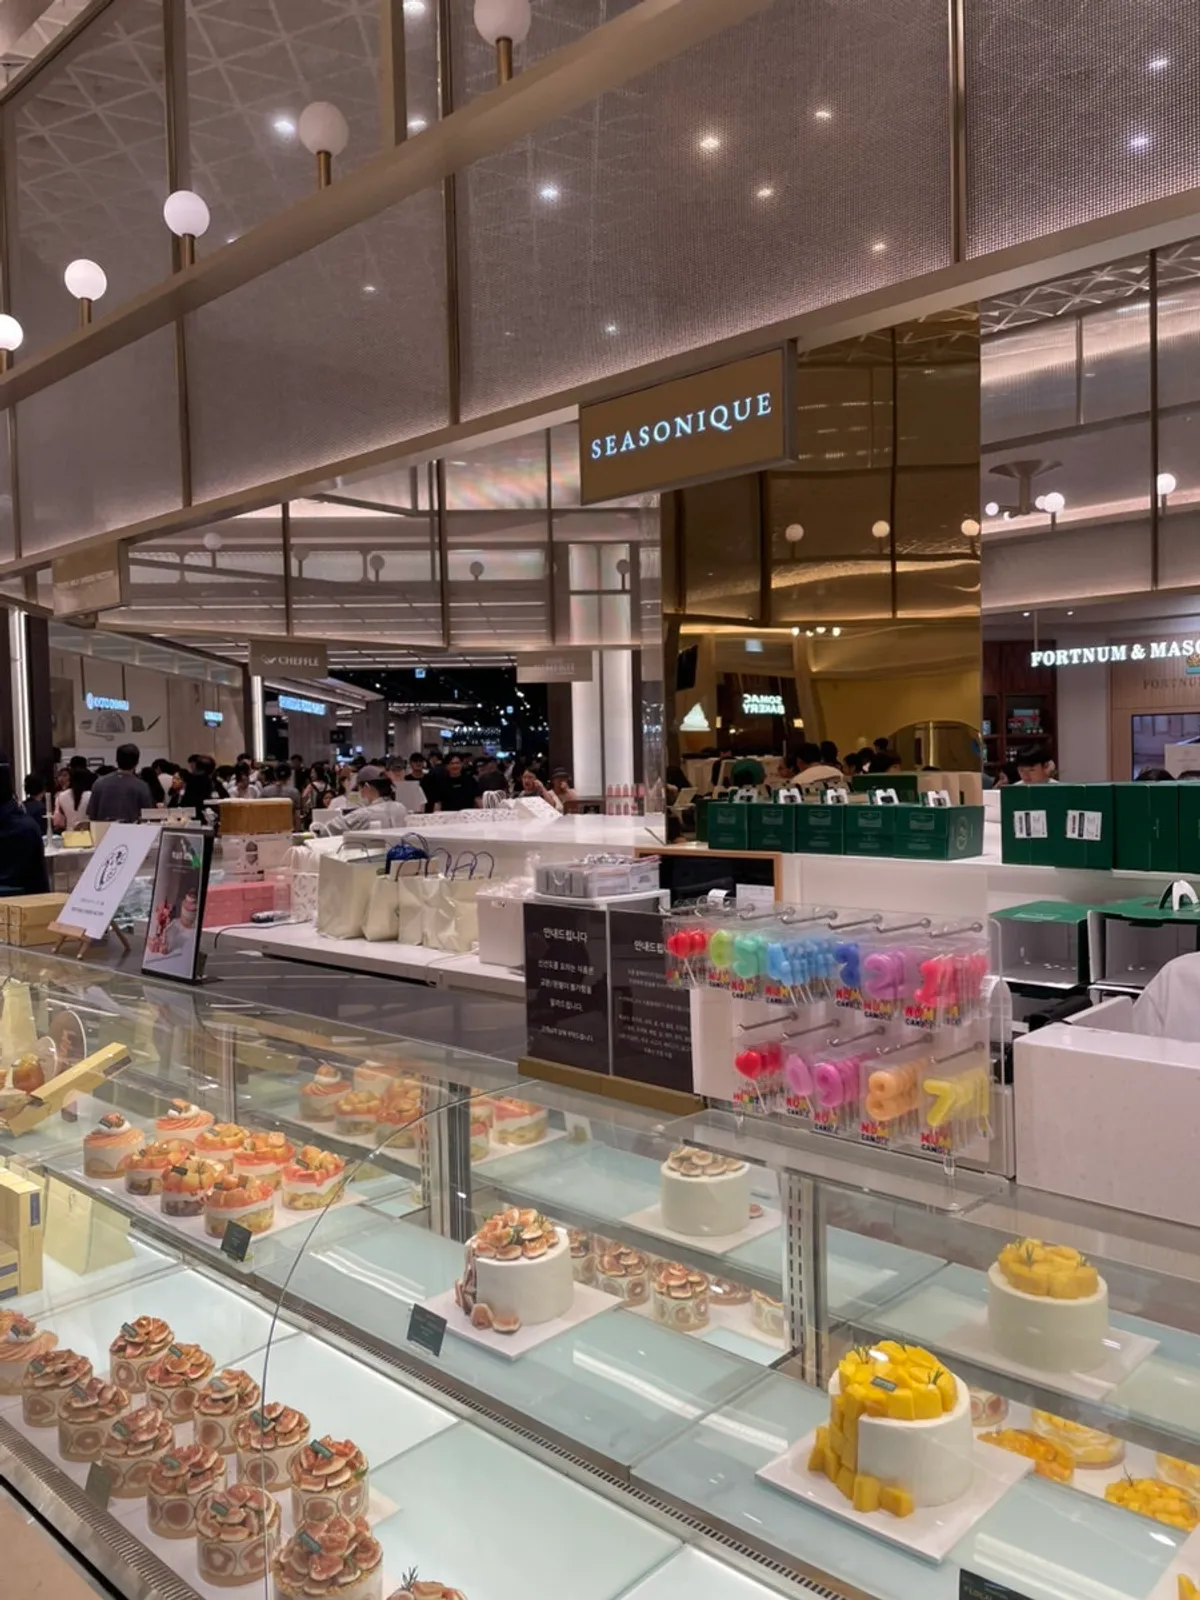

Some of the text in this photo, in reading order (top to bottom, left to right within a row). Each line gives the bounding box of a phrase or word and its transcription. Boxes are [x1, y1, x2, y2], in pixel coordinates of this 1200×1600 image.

[591, 392, 772, 460] SEASONIQUE
[1030, 645, 1127, 668] FORTNUM
[1131, 643, 1146, 660] &
[543, 927, 589, 944] 안내드립니다
